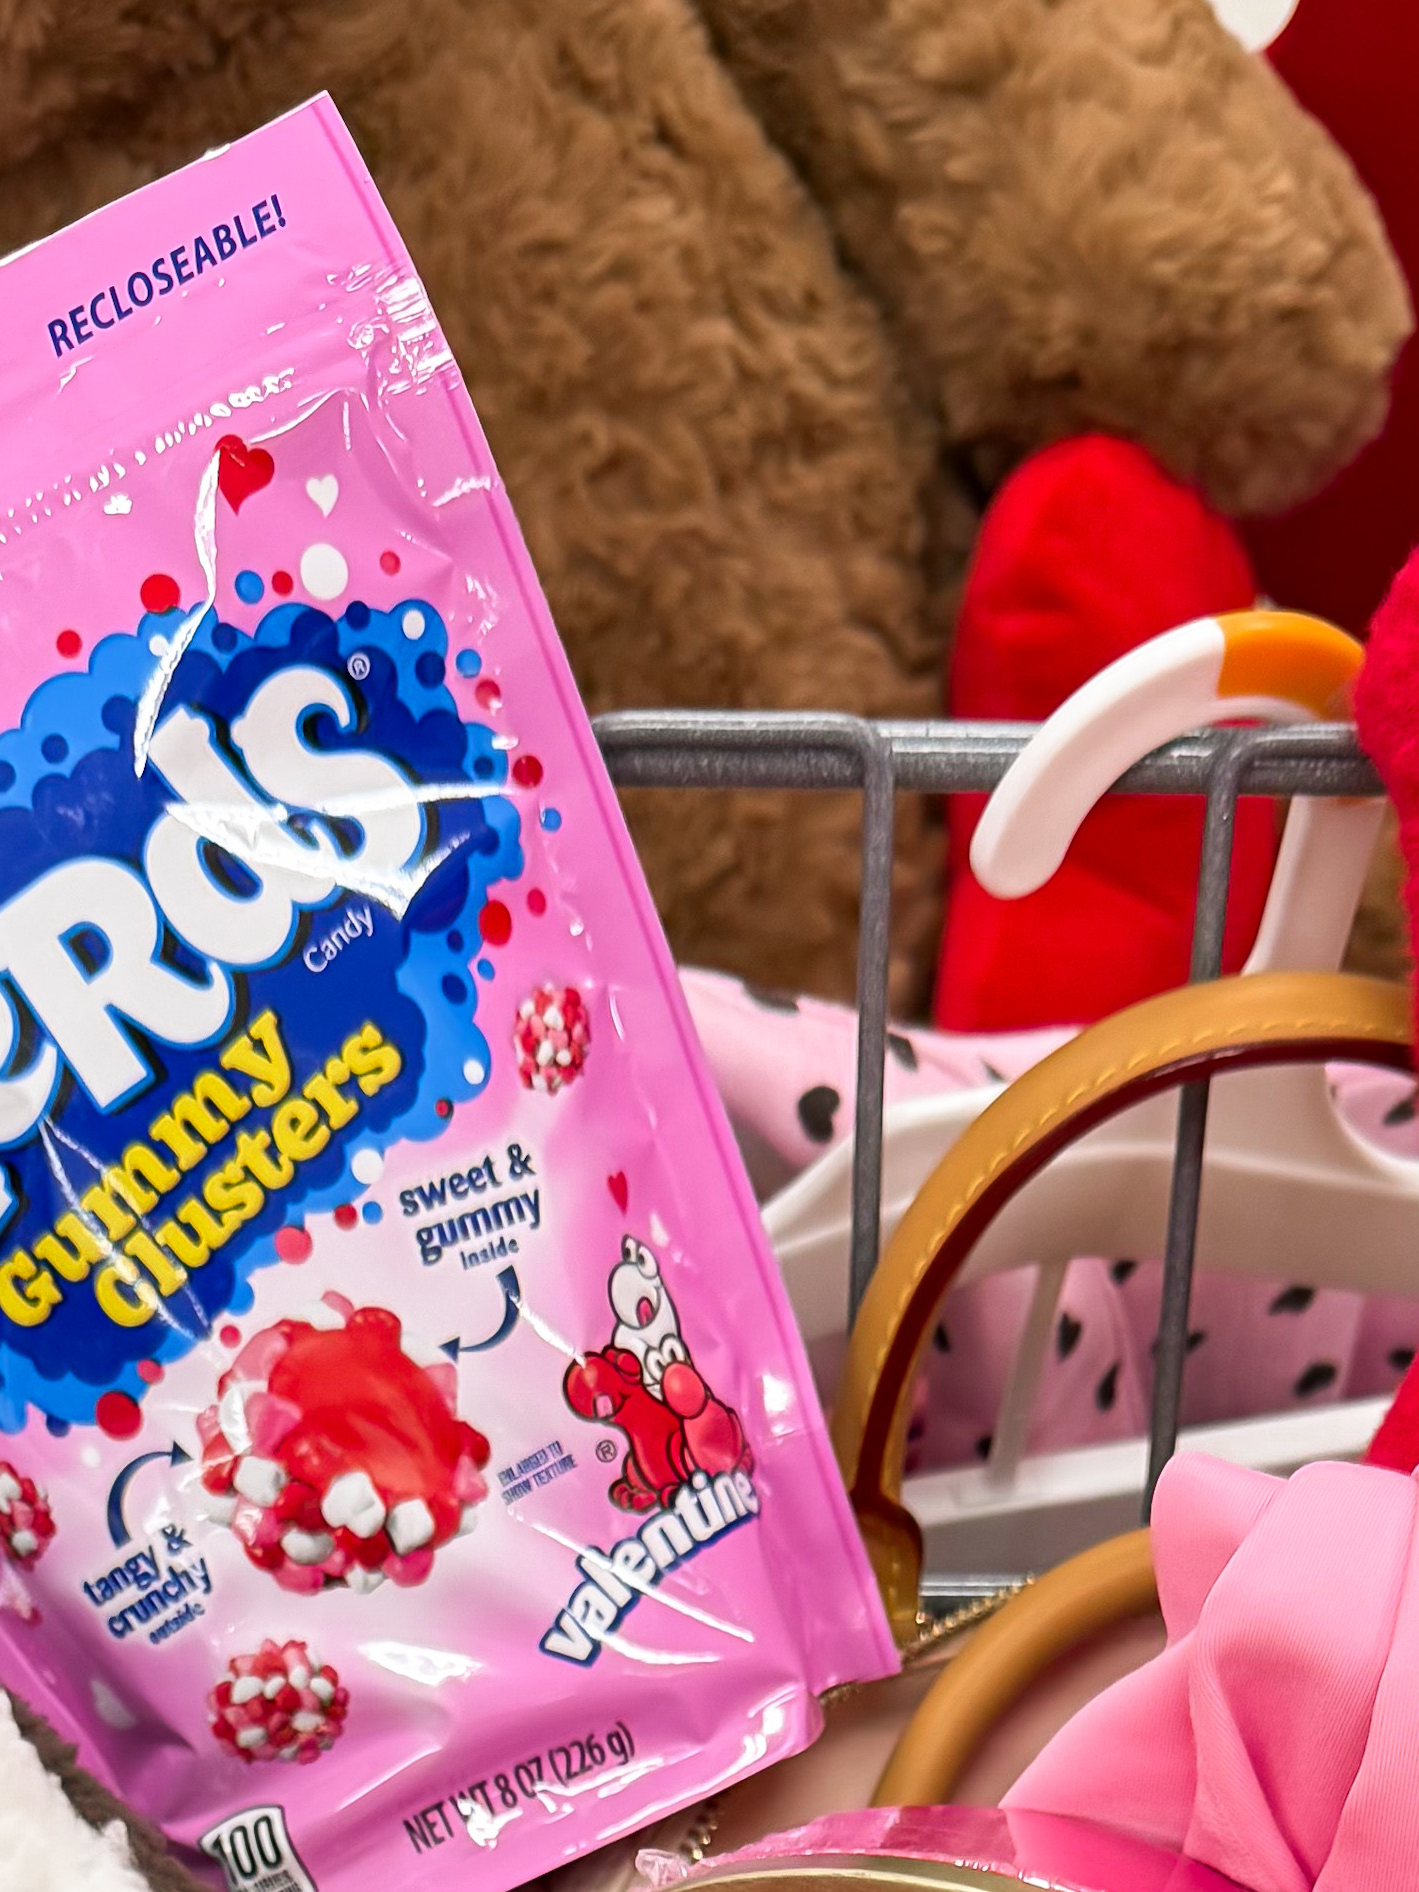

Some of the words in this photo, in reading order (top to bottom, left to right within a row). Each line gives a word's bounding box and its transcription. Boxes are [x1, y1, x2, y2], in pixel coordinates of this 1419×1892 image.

[47, 194, 286, 357] RECLOSEABLE!
[303, 904, 373, 972] Candy
[399, 1156, 503, 1216] sweet
[507, 1143, 537, 1181] &
[416, 1188, 540, 1266] gummy
[84, 1545, 160, 1606] tangy
[161, 1523, 193, 1554] &
[542, 1470, 759, 1663] valentine
[403, 1801, 454, 1854] NET
[494, 1773, 518, 1809] 8
[548, 1732, 605, 1787] (226
[605, 1721, 635, 1766] g)
[212, 1815, 283, 1885] 100
